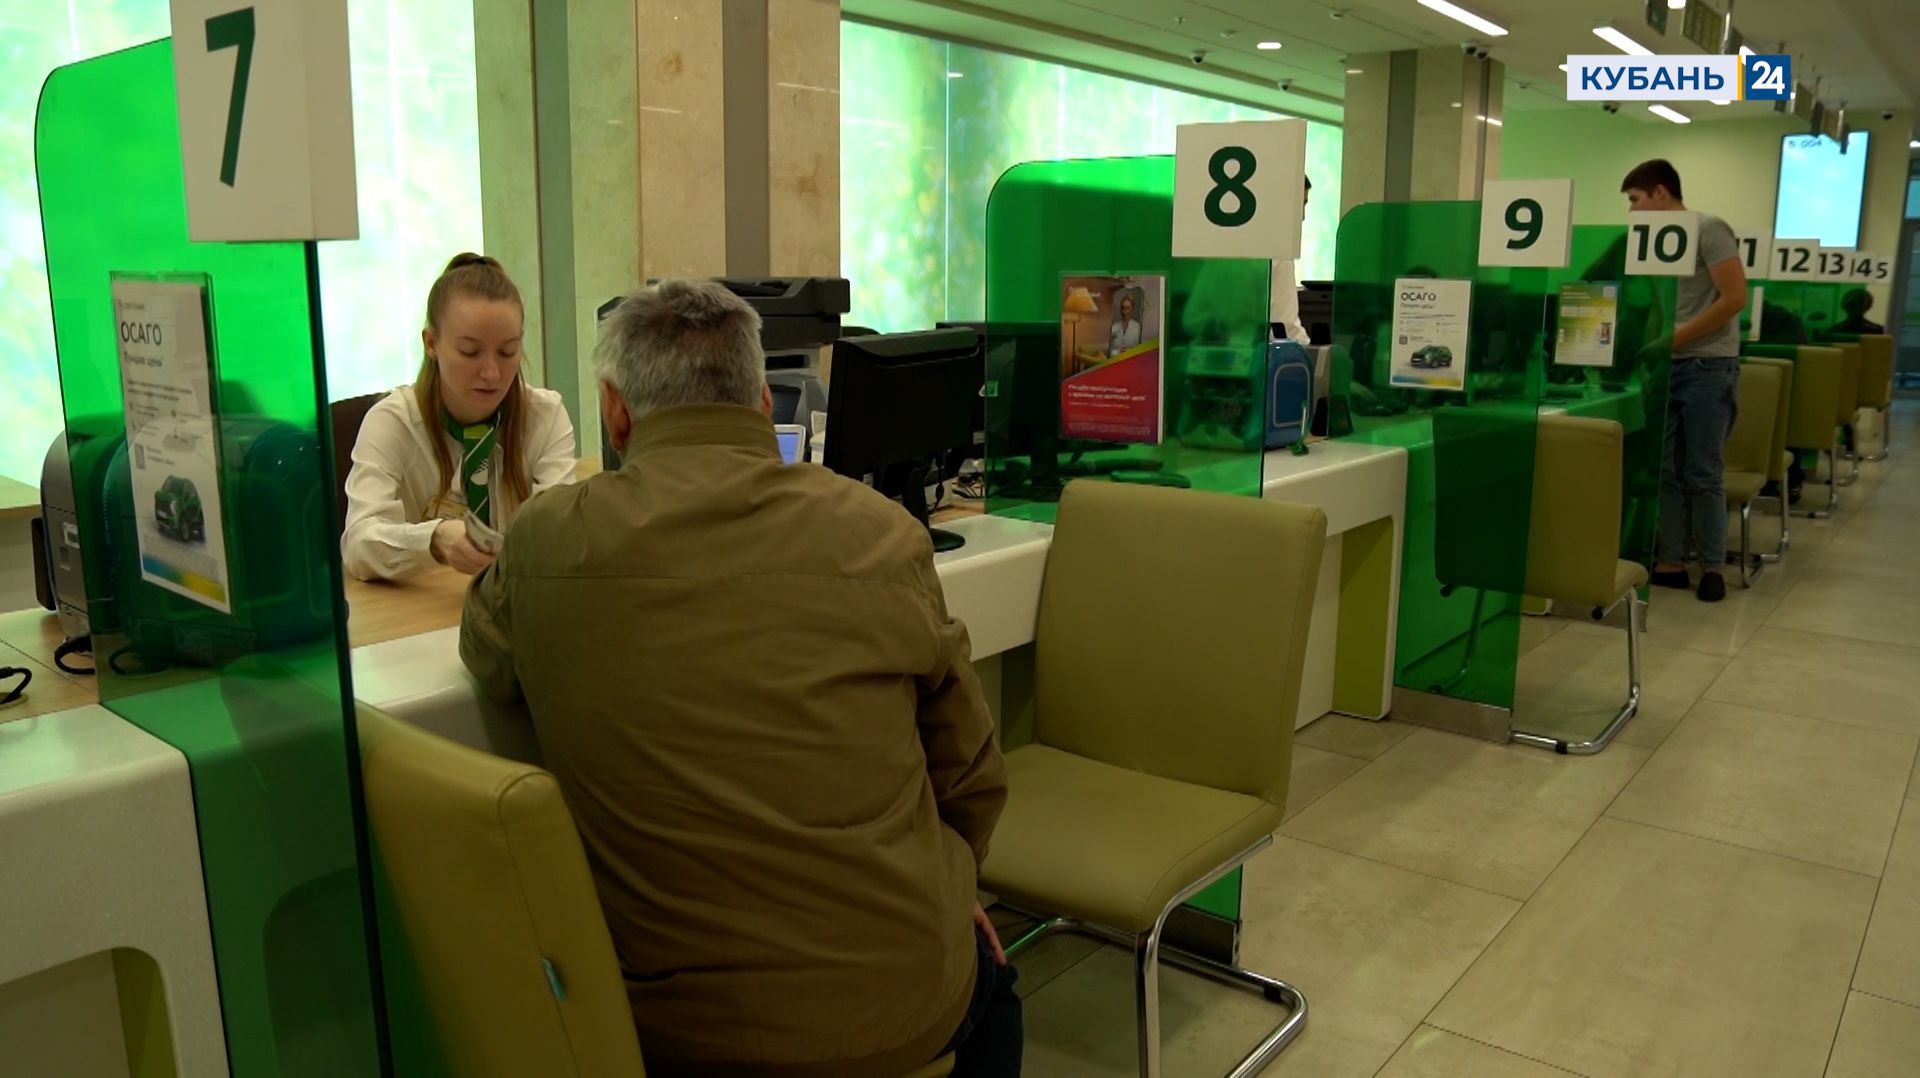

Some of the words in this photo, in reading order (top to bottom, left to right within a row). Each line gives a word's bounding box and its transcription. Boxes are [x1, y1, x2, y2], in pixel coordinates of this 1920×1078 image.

[204, 6, 256, 188] 7
[1203, 146, 1257, 228] 8
[1504, 198, 1544, 250] 9
[1632, 224, 1688, 263] 10
[1777, 248, 1811, 273] 12
[1818, 252, 1845, 275] 13
[1875, 262, 1889, 279] 5
[1400, 291, 1437, 302] ОСАГО
[120, 321, 163, 347] ОСАГО
